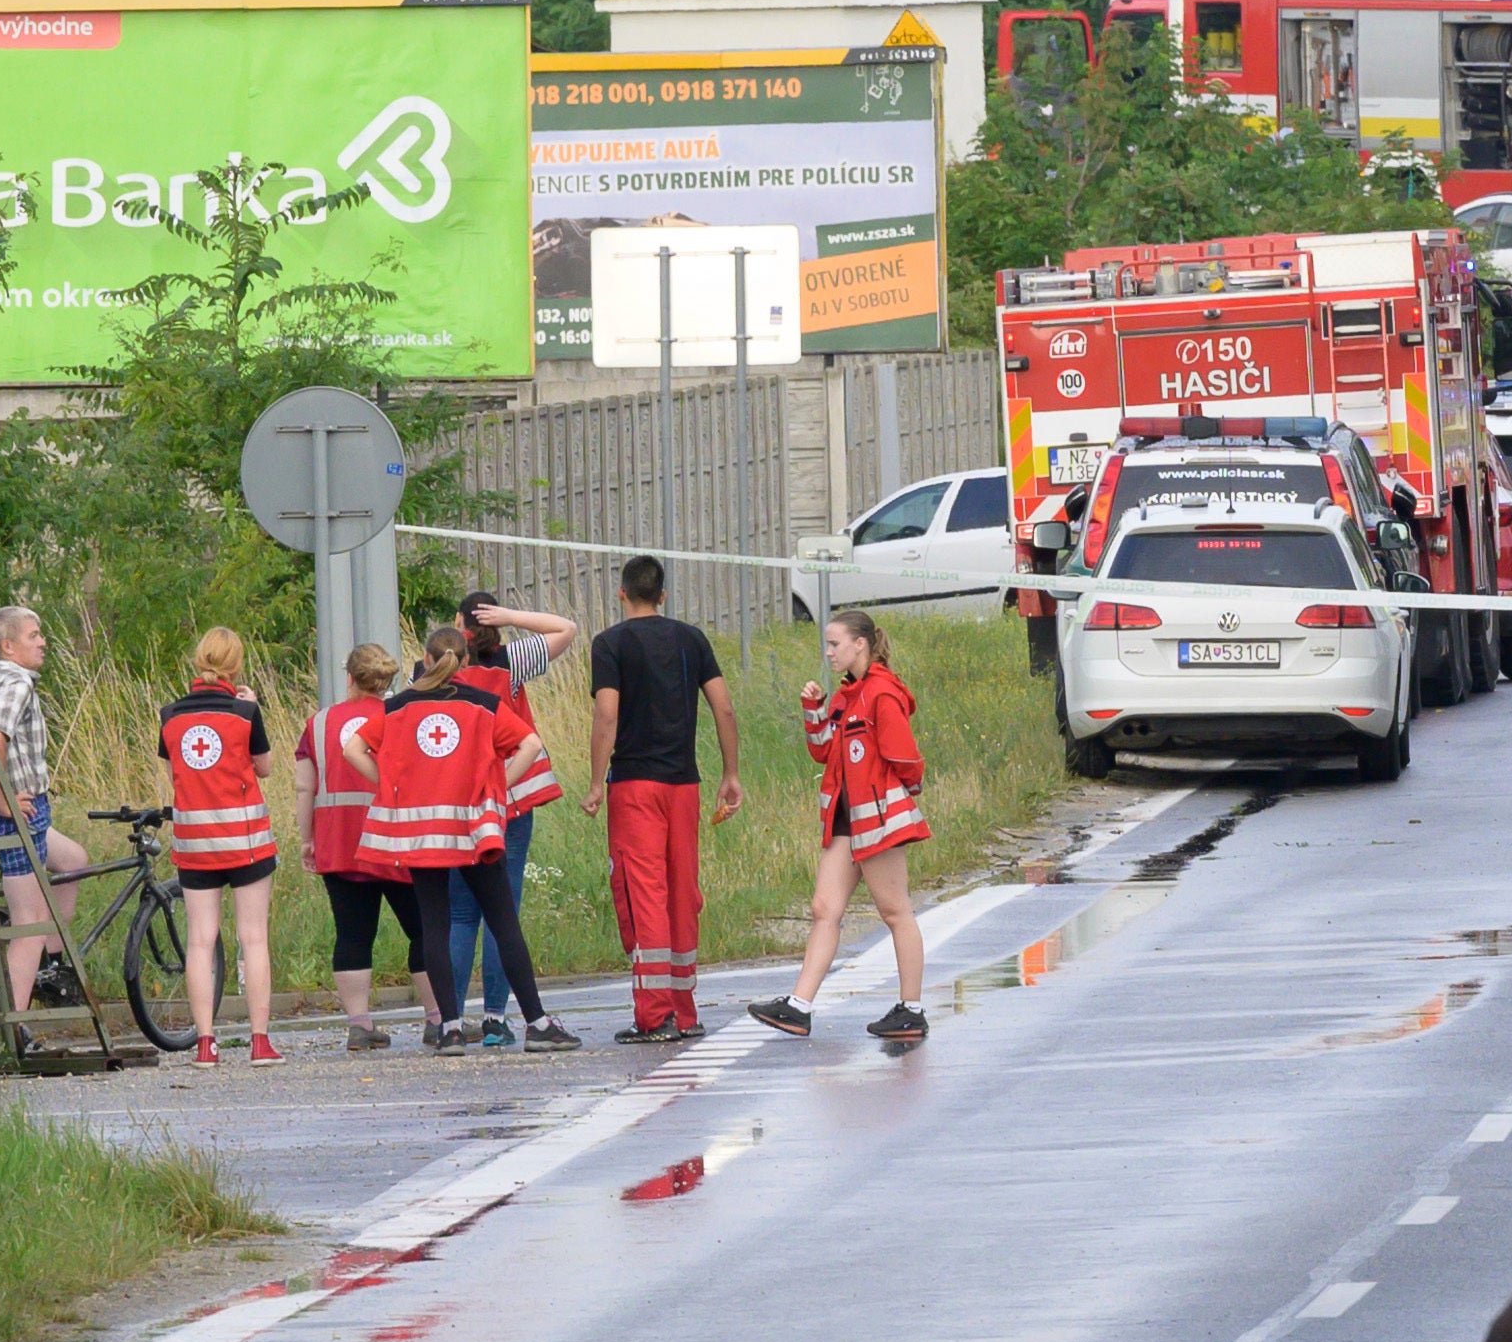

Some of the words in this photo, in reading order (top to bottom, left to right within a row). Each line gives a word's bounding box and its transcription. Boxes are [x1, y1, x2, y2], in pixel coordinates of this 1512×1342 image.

[0, 15, 94, 39] výhodne
[565, 83, 604, 105] 218
[607, 82, 655, 106] 001,
[660, 79, 716, 103] 0918
[722, 79, 758, 100] 371
[764, 77, 803, 99] 140
[530, 140, 657, 164] YKUPUJEME
[663, 134, 720, 160] AUTÁ
[50, 152, 327, 228] Banka
[598, 174, 610, 193] S
[617, 166, 751, 192] POTVRDENÍM
[758, 168, 795, 187] PRE
[802, 162, 881, 185] POLÍCIU
[887, 165, 915, 184] SR
[827, 223, 916, 245] www.zsza.sk
[805, 254, 907, 292] OTVORENÉ
[810, 301, 828, 316] AJ
[831, 298, 843, 314] V
[848, 287, 911, 311] SOBOTU
[536, 308, 566, 326] 132,
[560, 329, 593, 345] 16:0
[1200, 336, 1253, 363] 150
[1059, 373, 1083, 391] 100
[1159, 361, 1272, 400] HASIČI
[1069, 449, 1090, 465] NZ
[1054, 463, 1097, 482] 713E
[1191, 644, 1213, 662] SA
[1221, 644, 1277, 661] 531CL
